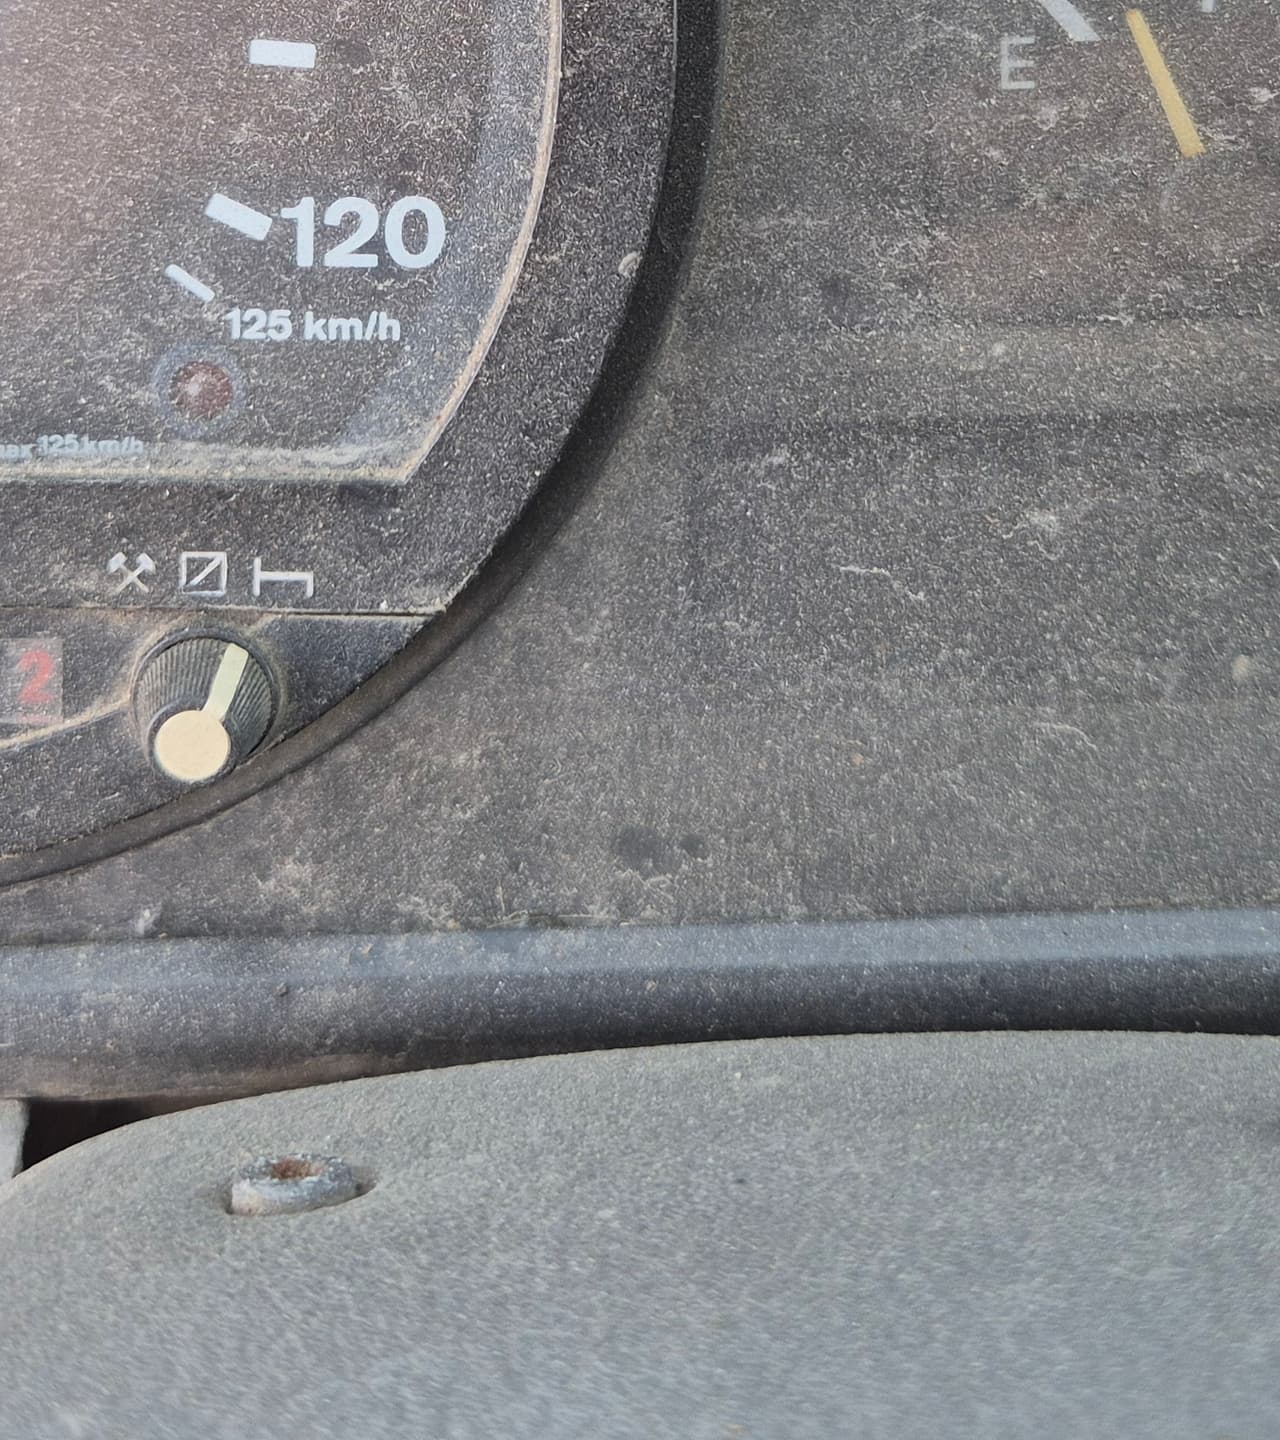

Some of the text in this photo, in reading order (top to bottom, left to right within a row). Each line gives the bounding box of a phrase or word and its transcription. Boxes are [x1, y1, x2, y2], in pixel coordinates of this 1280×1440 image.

[1001, 37, 1035, 89] E
[280, 195, 447, 269] 120
[224, 308, 400, 341] 125 km/h
